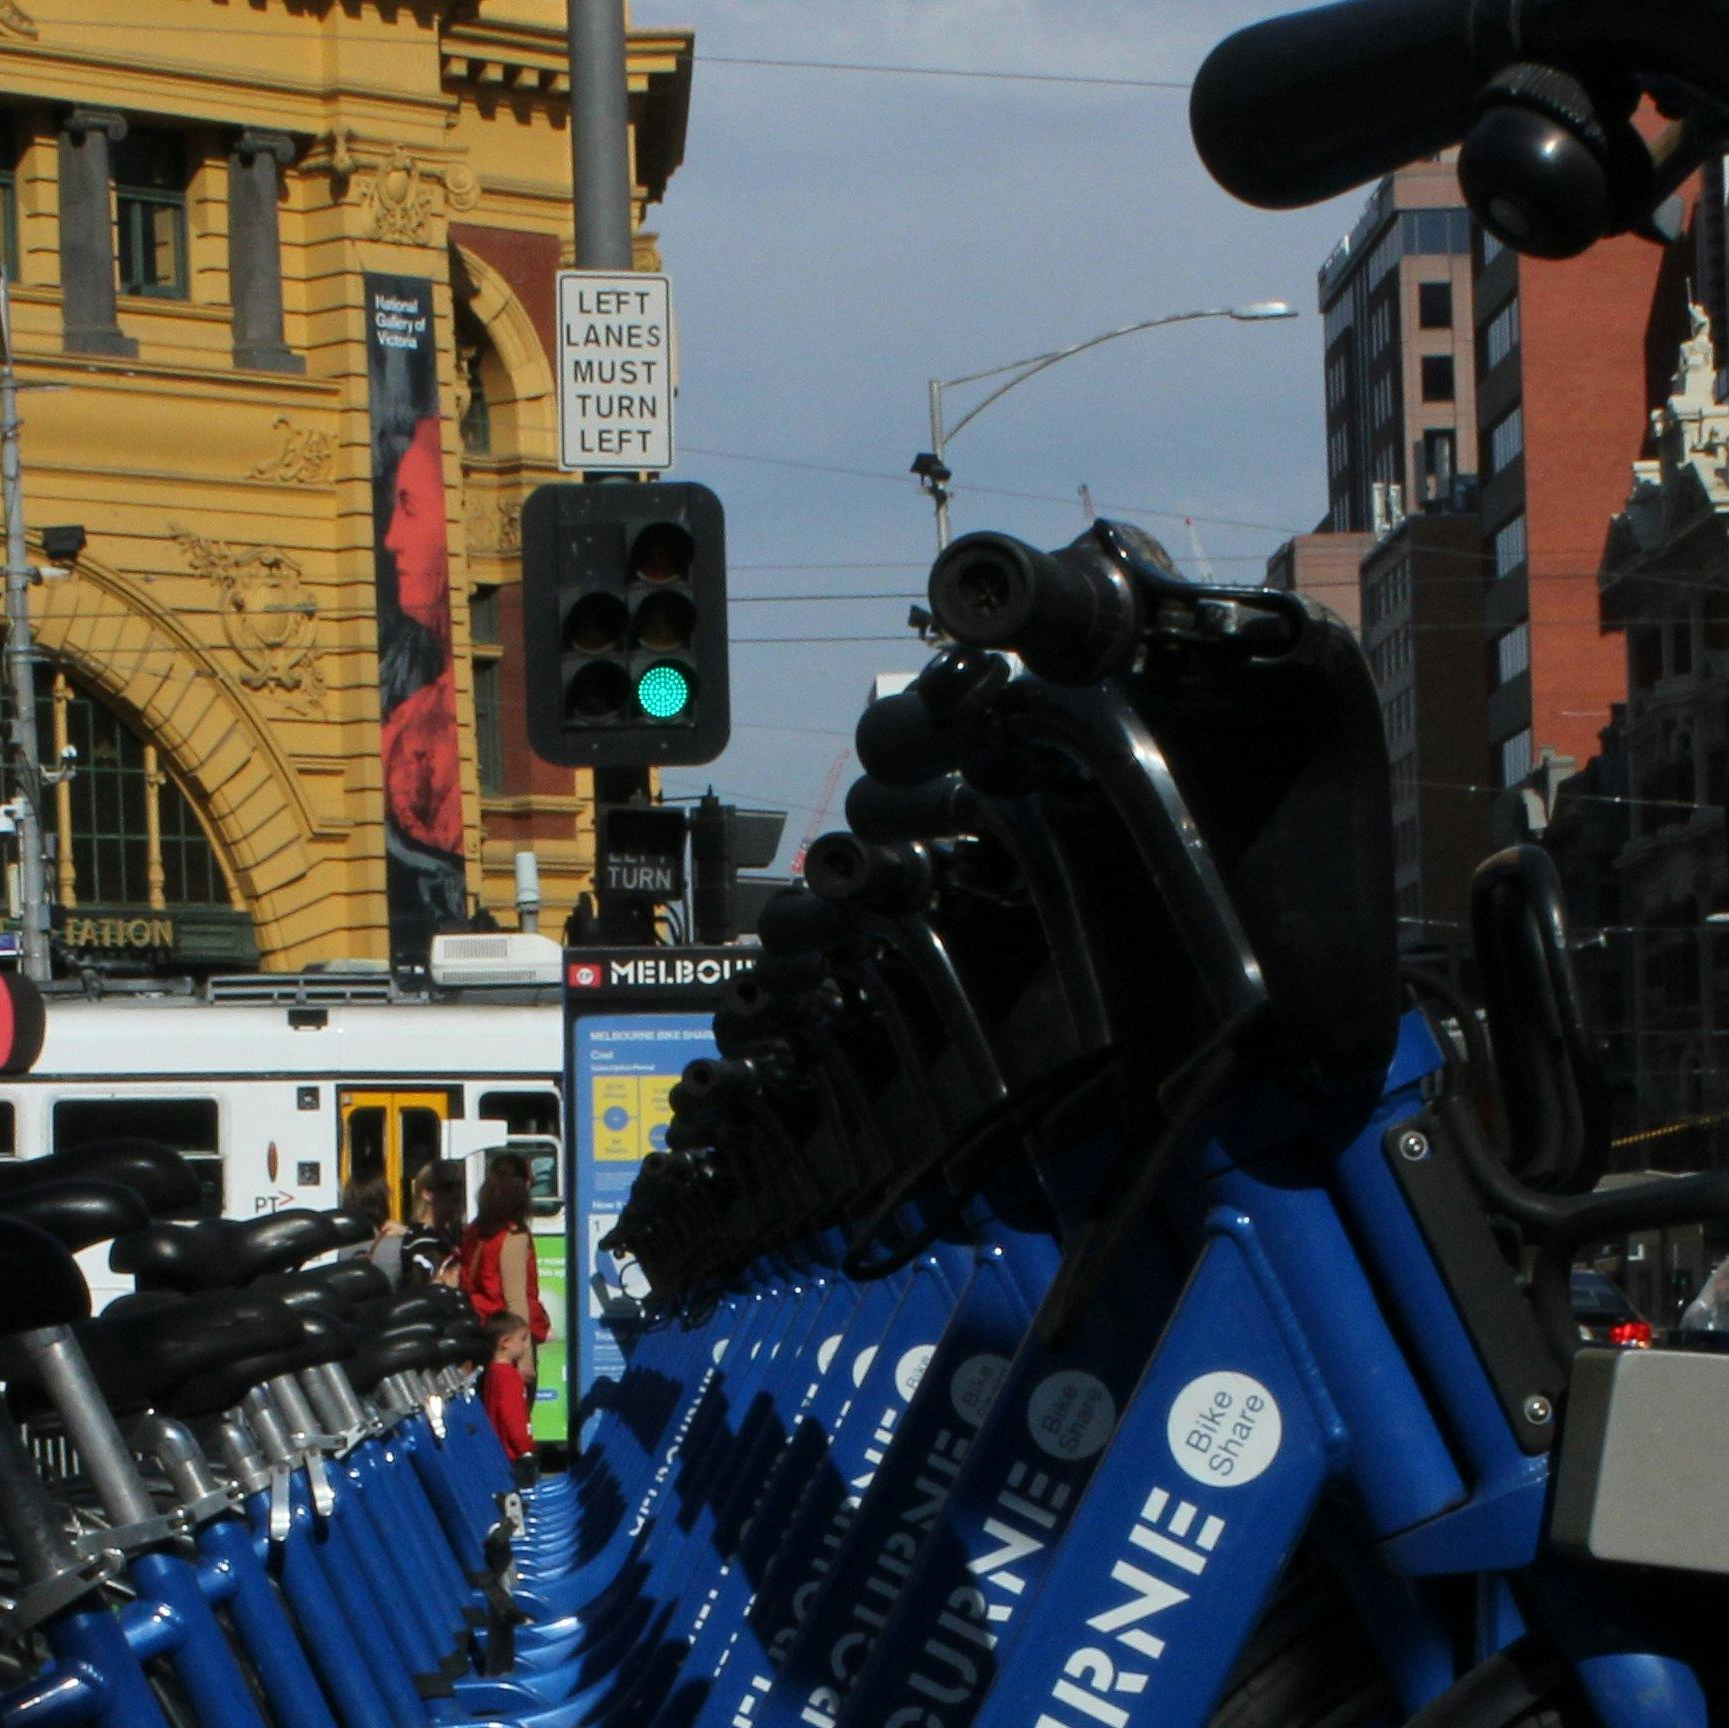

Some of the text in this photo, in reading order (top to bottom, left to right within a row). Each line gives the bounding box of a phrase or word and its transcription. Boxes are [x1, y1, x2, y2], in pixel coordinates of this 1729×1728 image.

[375, 294, 418, 314] National
[578, 290, 651, 316] LEFT
[375, 312, 426, 336] Gallery of
[565, 322, 662, 349] LANES
[376, 330, 418, 349] Victoria
[573, 360, 657, 386] MUST
[576, 394, 658, 419] TURN
[580, 429, 652, 454] LEFT
[608, 866, 672, 890] TURN
[51, 917, 174, 947] TATION
[1041, 1384, 1077, 1434] Bike
[1185, 1391, 1233, 1454] Bike
[1209, 1395, 1265, 1477] Share
